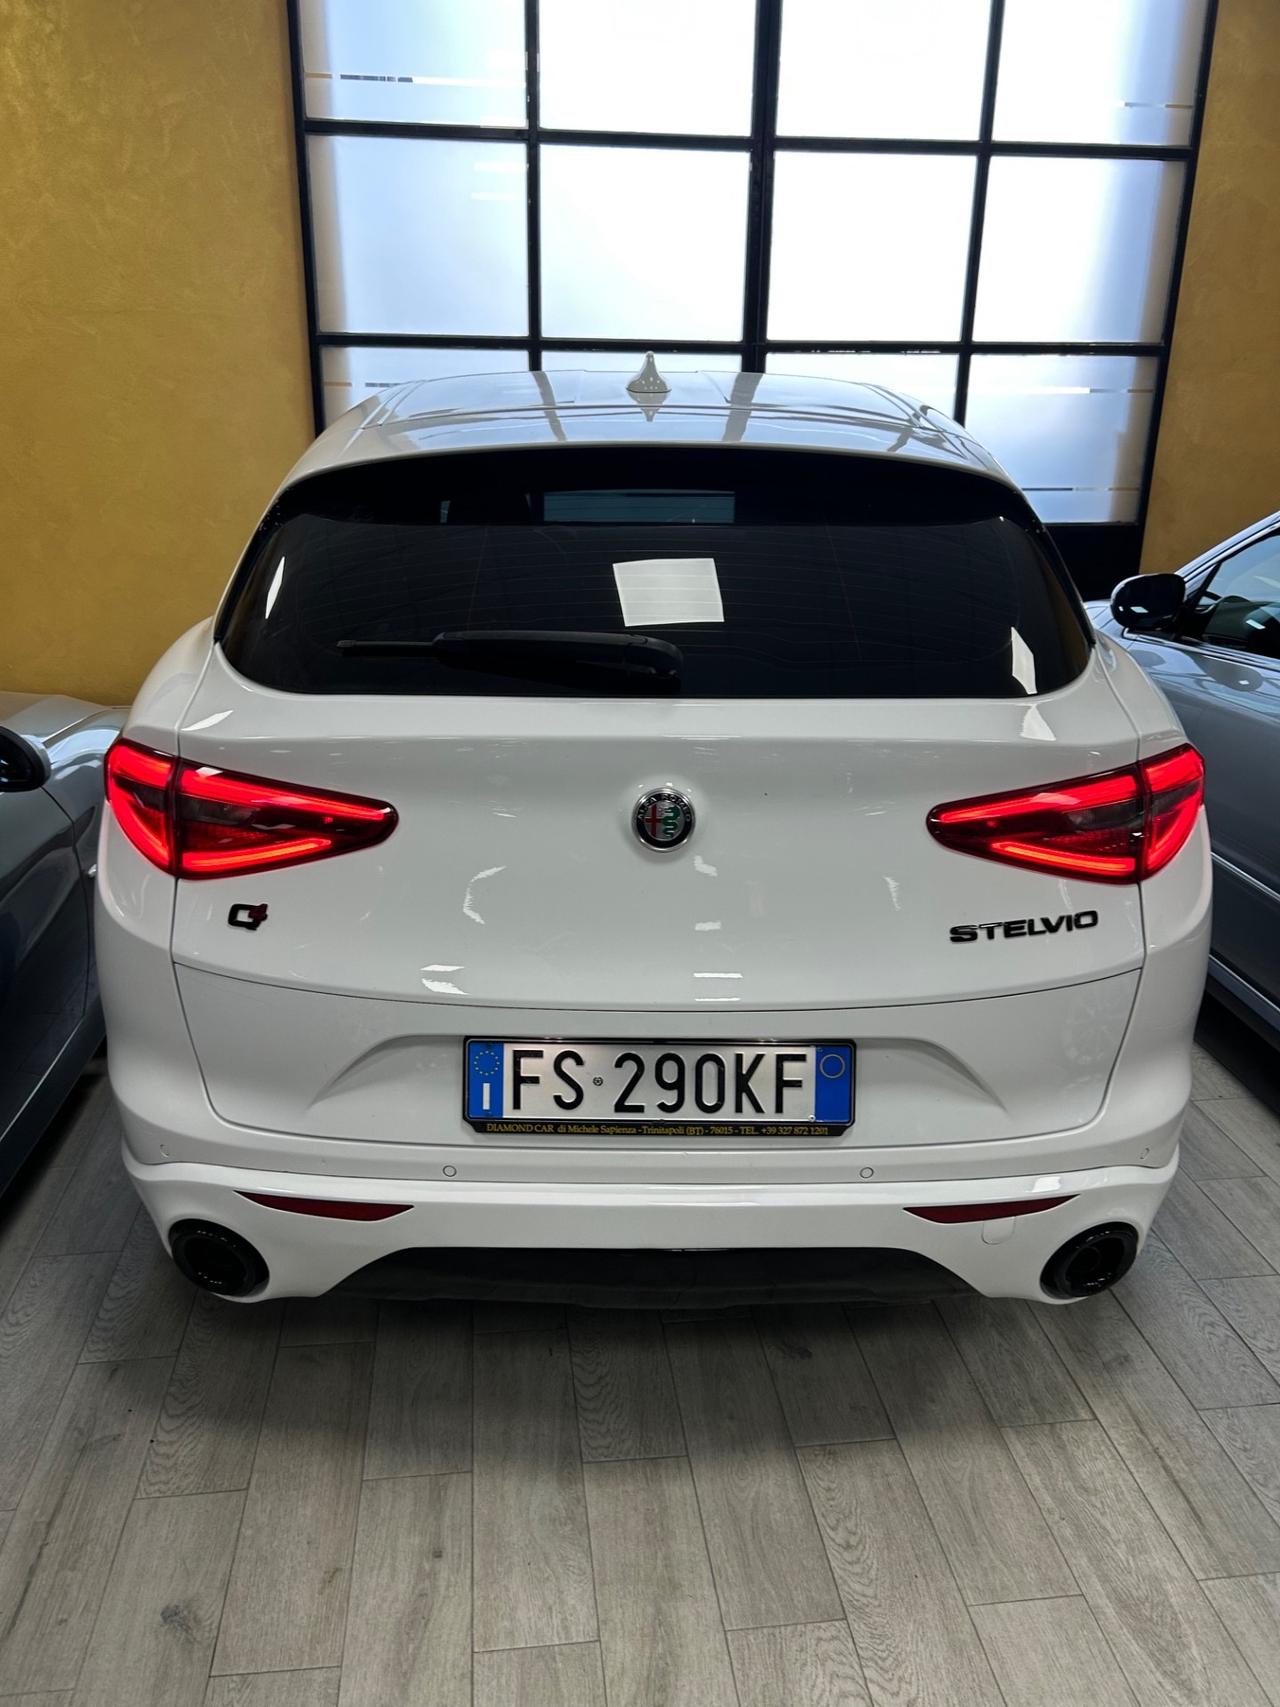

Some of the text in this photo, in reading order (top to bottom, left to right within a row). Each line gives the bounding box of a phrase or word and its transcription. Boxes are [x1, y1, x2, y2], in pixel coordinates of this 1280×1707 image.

[949, 910, 1099, 943] STELVIO
[512, 1049, 808, 1115] FS 290KF
[486, 1124, 533, 1133] DIAMOND
[534, 1124, 554, 1133] CAR
[557, 1124, 566, 1133] di
[569, 1125, 599, 1134] Michele
[600, 1125, 637, 1135] Sapienza
[643, 1125, 685, 1136] Trinitapoli
[686, 1126, 704, 1136] (BT)
[761, 1127, 777, 1135] +39
[777, 1127, 792, 1135] 327
[793, 1127, 808, 1135] 872
